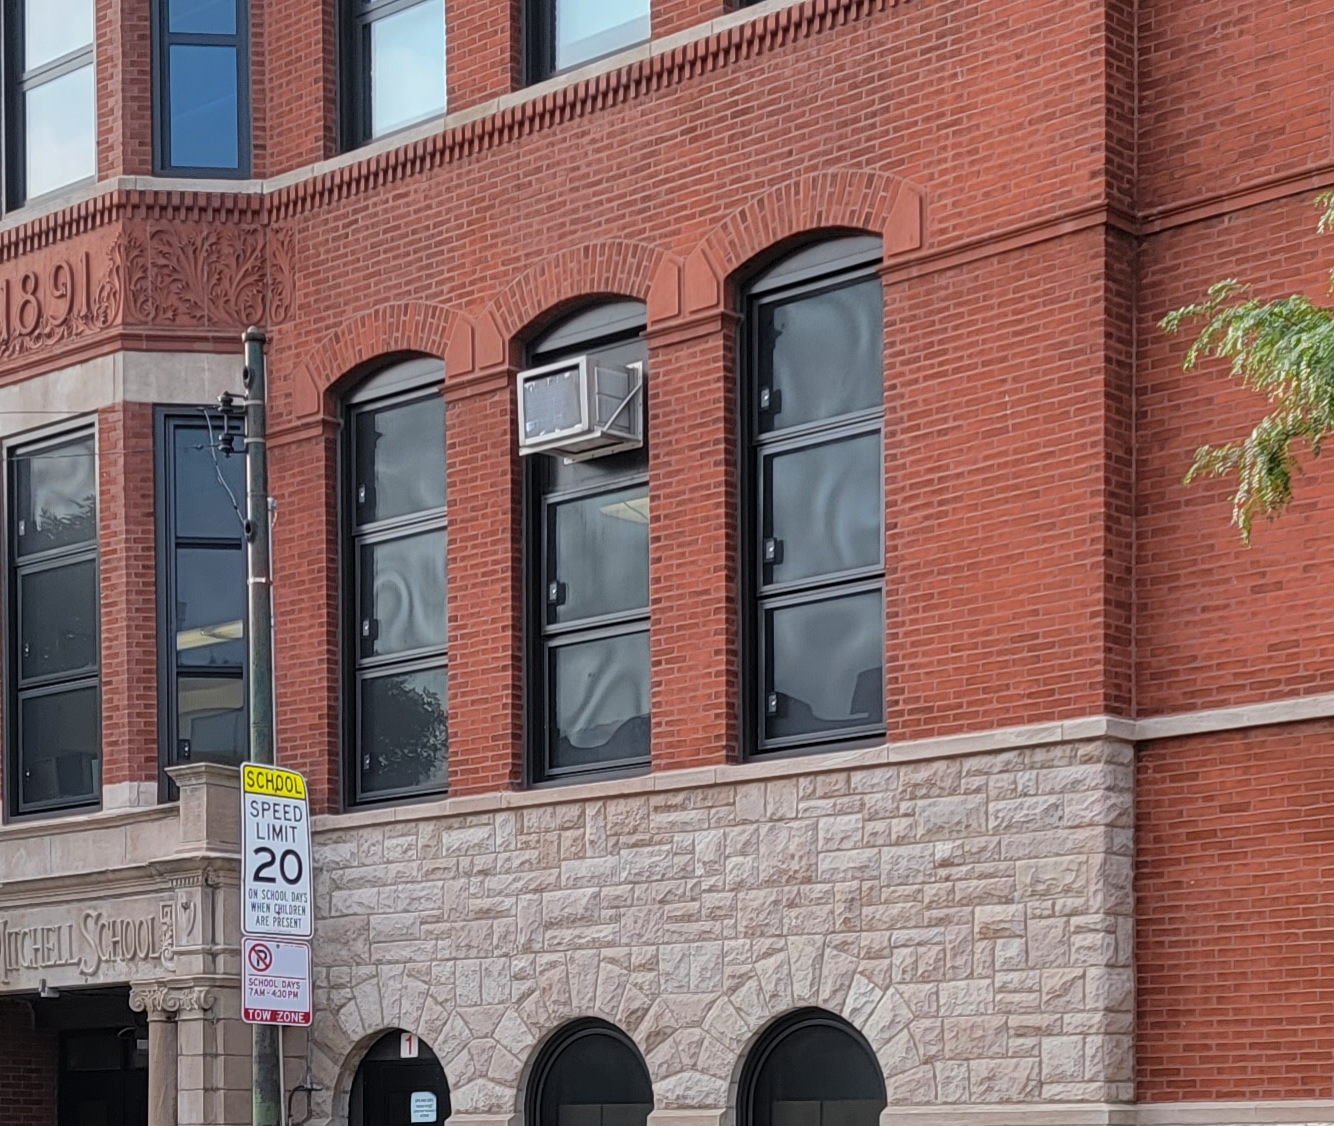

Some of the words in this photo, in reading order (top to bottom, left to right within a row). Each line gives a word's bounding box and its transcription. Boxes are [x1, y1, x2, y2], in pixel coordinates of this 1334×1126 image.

[1, 251, 92, 346] 1891
[247, 770, 302, 795] SCHOOL
[250, 800, 303, 822] SPEED
[256, 822, 298, 843] LIMIT
[253, 846, 303, 885] 20
[248, 888, 258, 899] ON
[262, 889, 288, 902] SCHOOL
[291, 891, 308, 903] DAYS
[251, 902, 271, 914] WHEN
[274, 903, 306, 916] CHILDREN
[255, 915, 270, 927] ARE
[273, 916, 302, 929] PRESENT
[78, 909, 162, 977] SCHOOL
[248, 977, 278, 988] SCHOOL
[281, 980, 301, 990] DAYS
[247, 1009, 271, 1021] TOW
[276, 1011, 306, 1024] ZONE
[405, 1034, 413, 1055] 1
